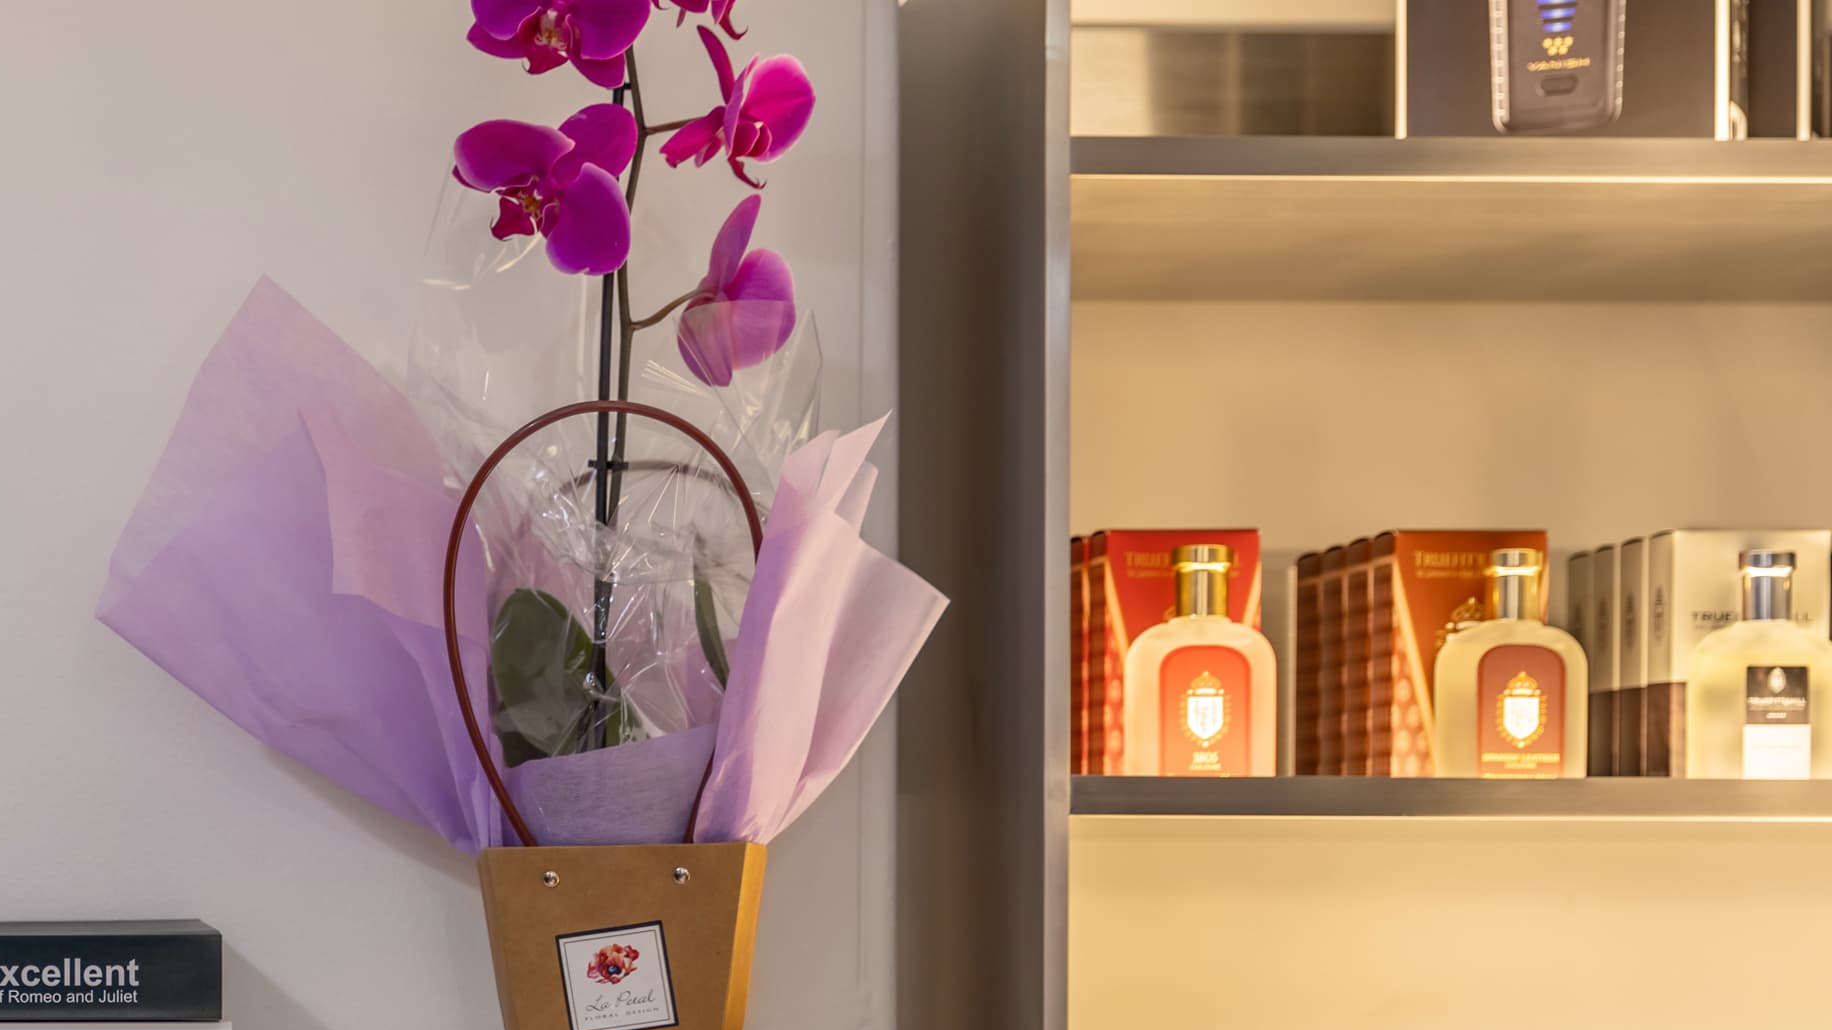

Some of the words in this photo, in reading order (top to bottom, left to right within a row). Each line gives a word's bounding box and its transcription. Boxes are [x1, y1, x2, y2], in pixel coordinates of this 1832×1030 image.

[8, 990, 62, 1004] Romeo
[66, 989, 94, 1004] and
[98, 989, 138, 1004] Juliet
